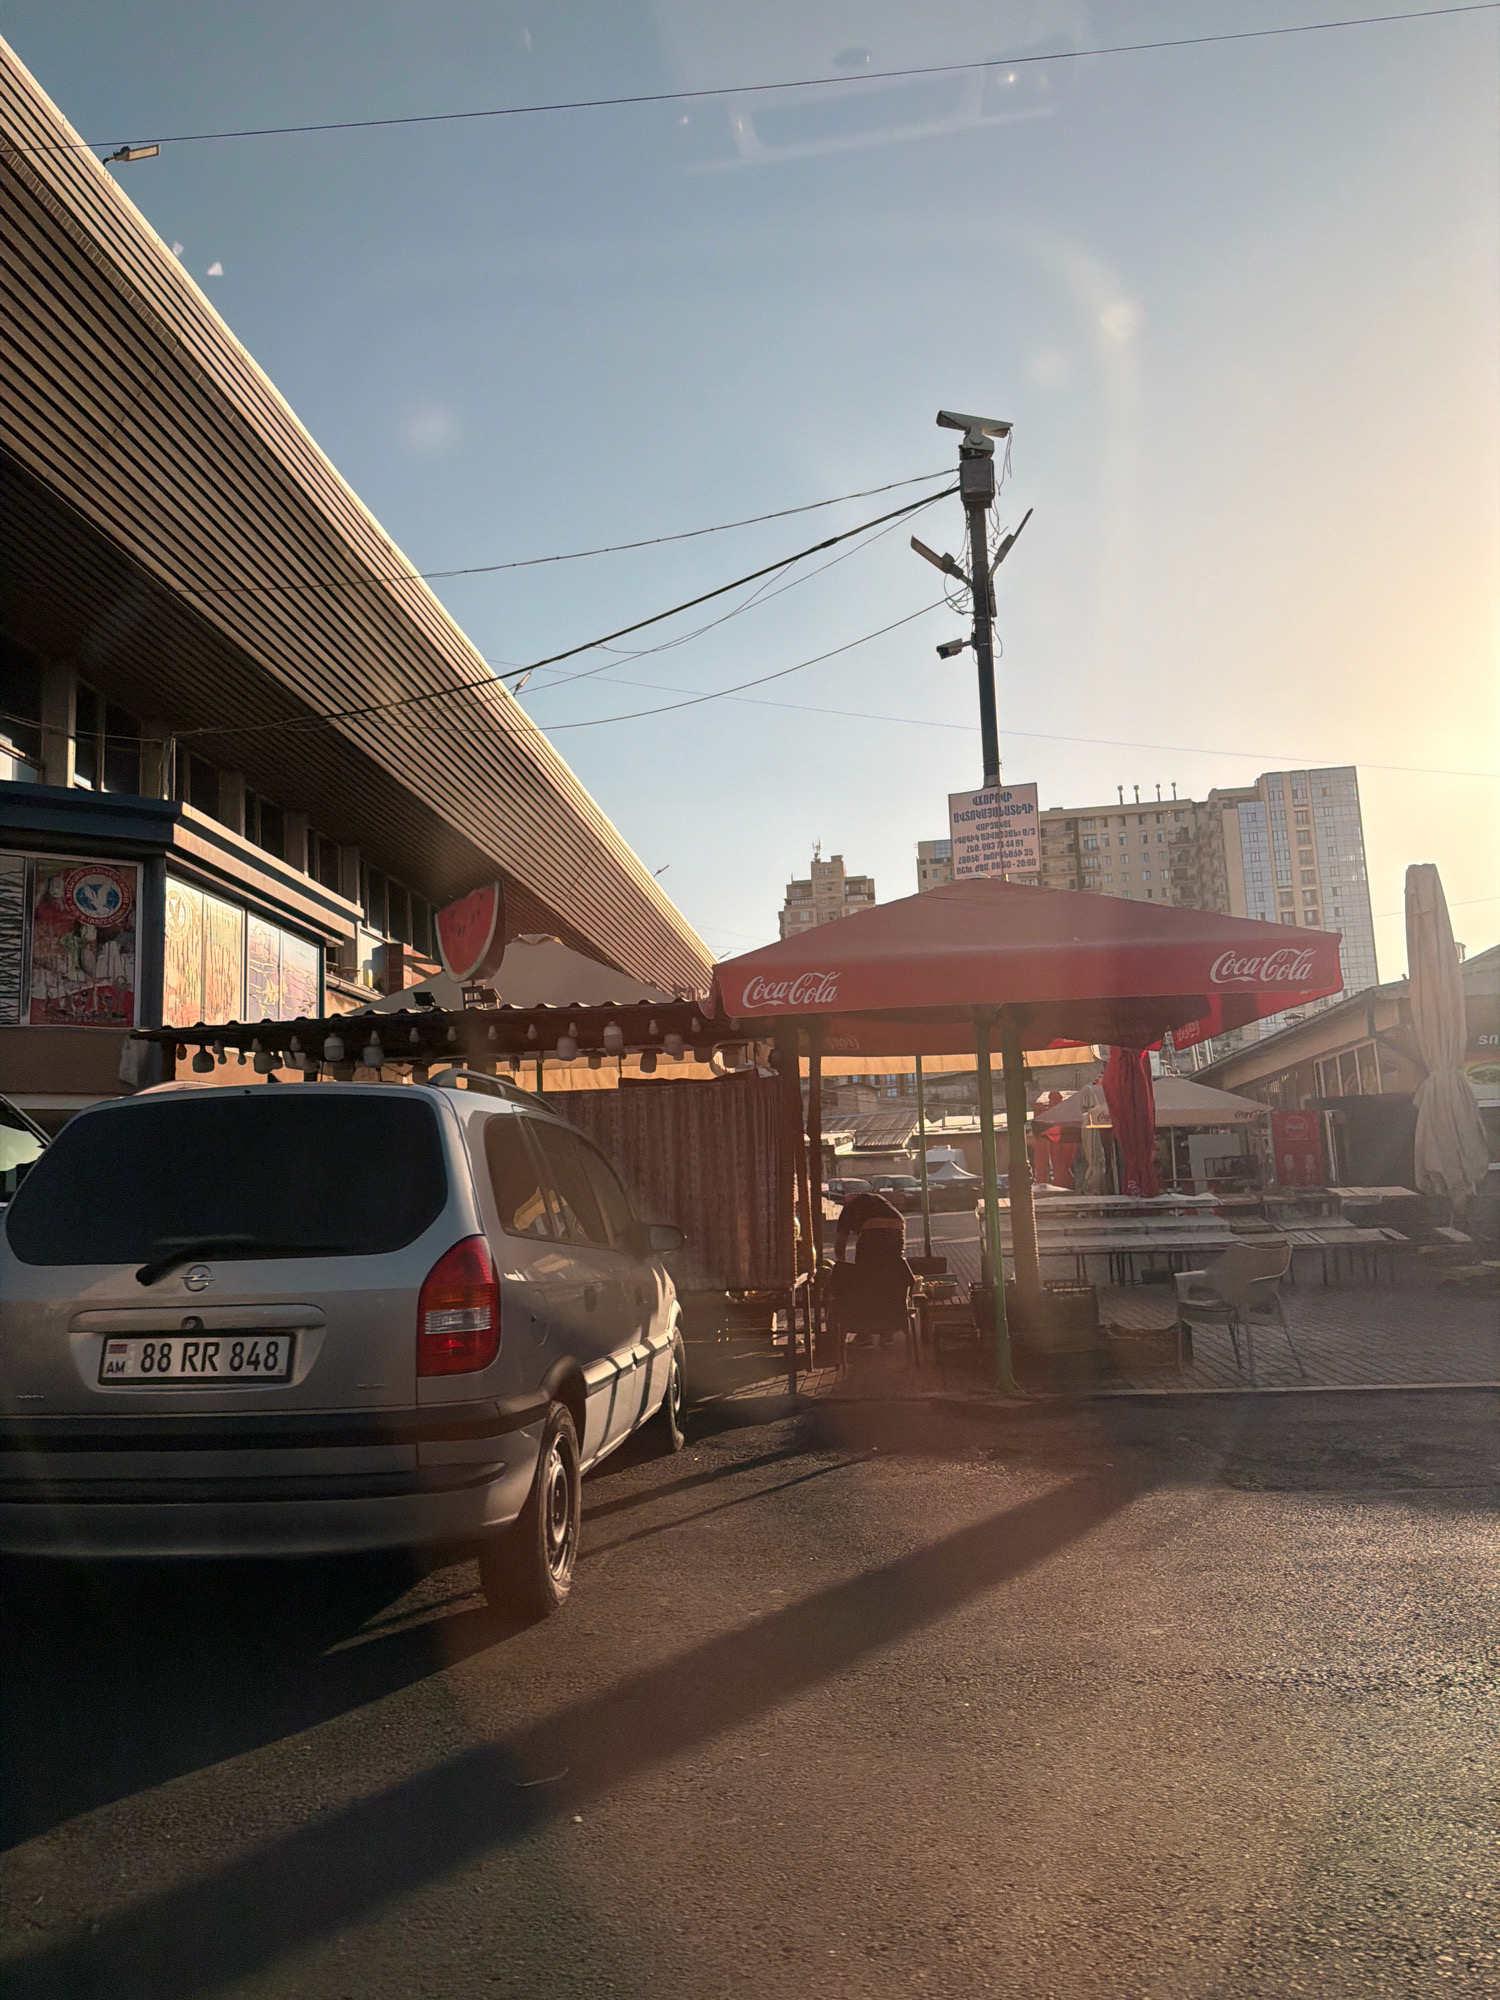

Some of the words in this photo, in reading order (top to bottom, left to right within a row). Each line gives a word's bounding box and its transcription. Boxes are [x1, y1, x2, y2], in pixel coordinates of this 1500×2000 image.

[972, 791, 1013, 806] ՎՃԱՐՈՎԻ
[953, 803, 1034, 823] ԱՎՏՈԿԱՅԱՆԱՏԵՂԻ
[982, 842, 995, 851] 093
[1005, 840, 1014, 848] 44
[1024, 848, 1034, 857] 35
[1210, 948, 1316, 984] Coca-Cola
[742, 971, 841, 1009] Coca-Cola
[140, 1342, 173, 1373] 88
[180, 1342, 220, 1372] RR
[229, 1341, 279, 1372] 848
[105, 1360, 126, 1374] AM
